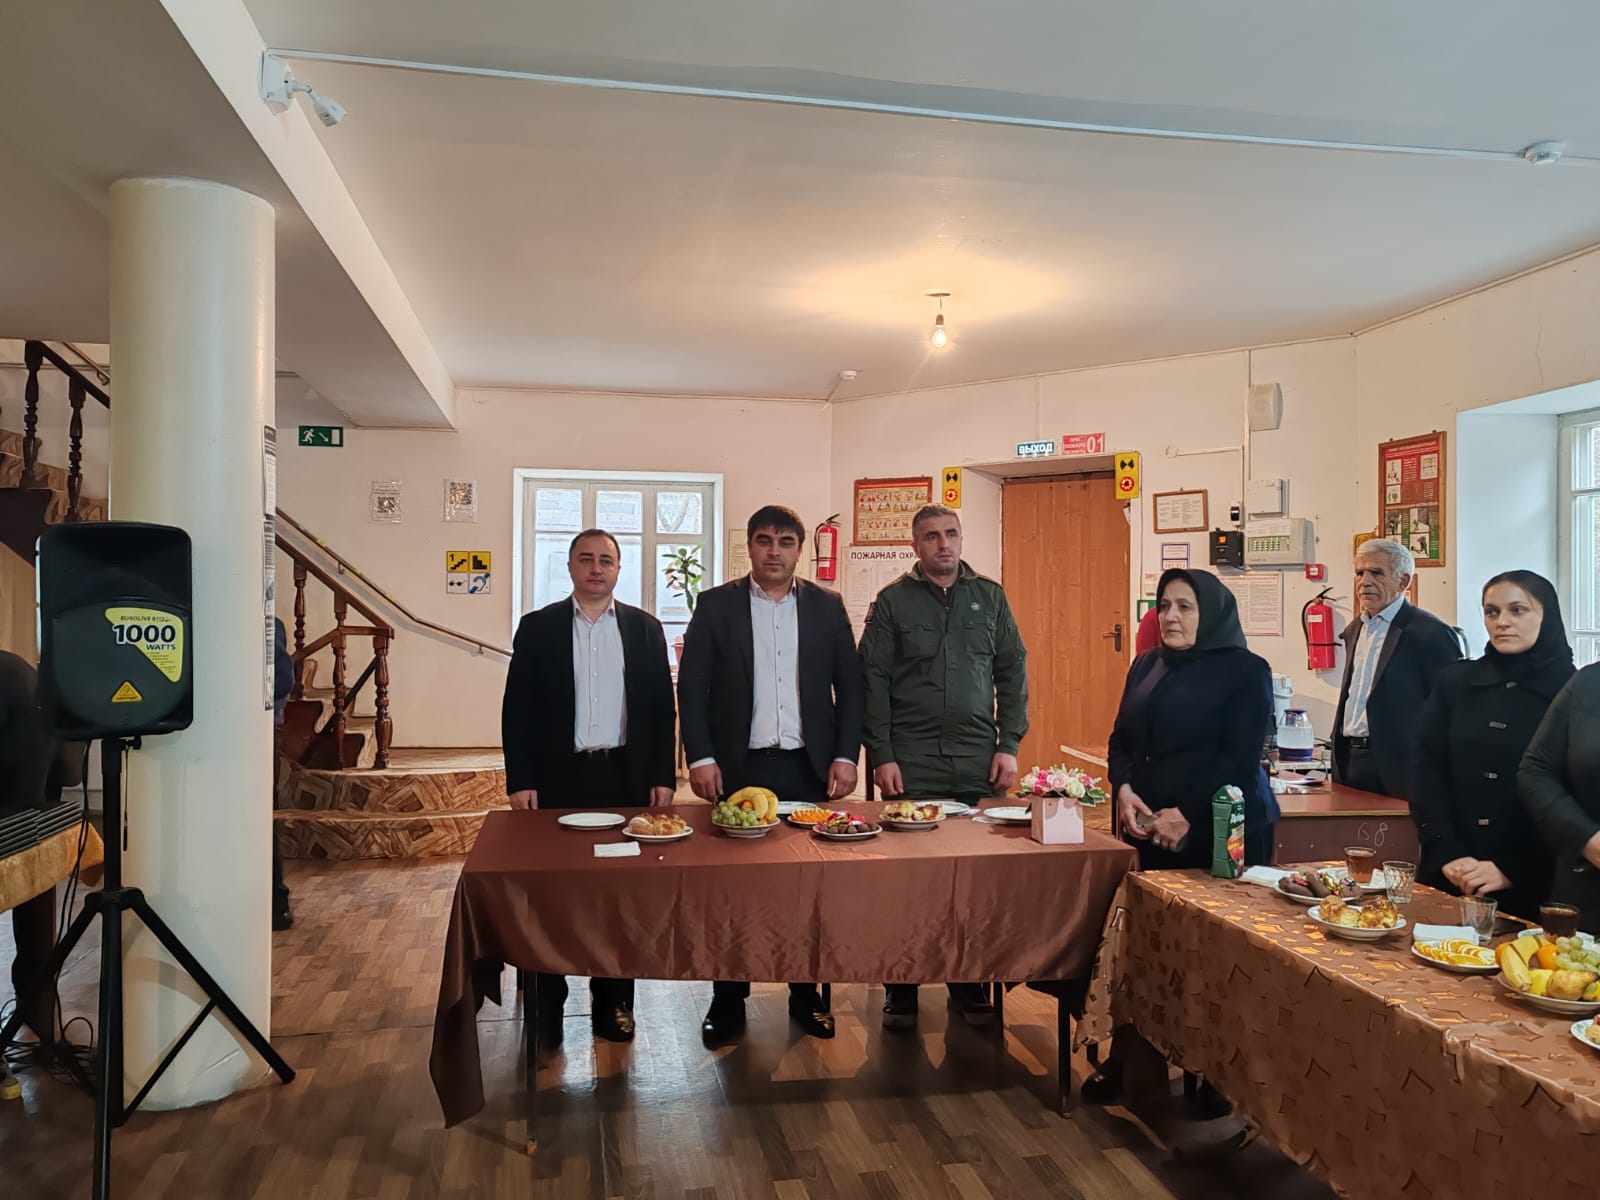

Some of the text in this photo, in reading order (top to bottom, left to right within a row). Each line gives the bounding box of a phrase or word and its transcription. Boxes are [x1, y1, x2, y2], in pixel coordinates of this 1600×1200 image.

[1018, 443, 1053, 454] ВЫХОД
[1086, 435, 1105, 453] 01
[851, 551, 897, 560] ПОЖАРНАЯ
[112, 624, 176, 644] 1000
